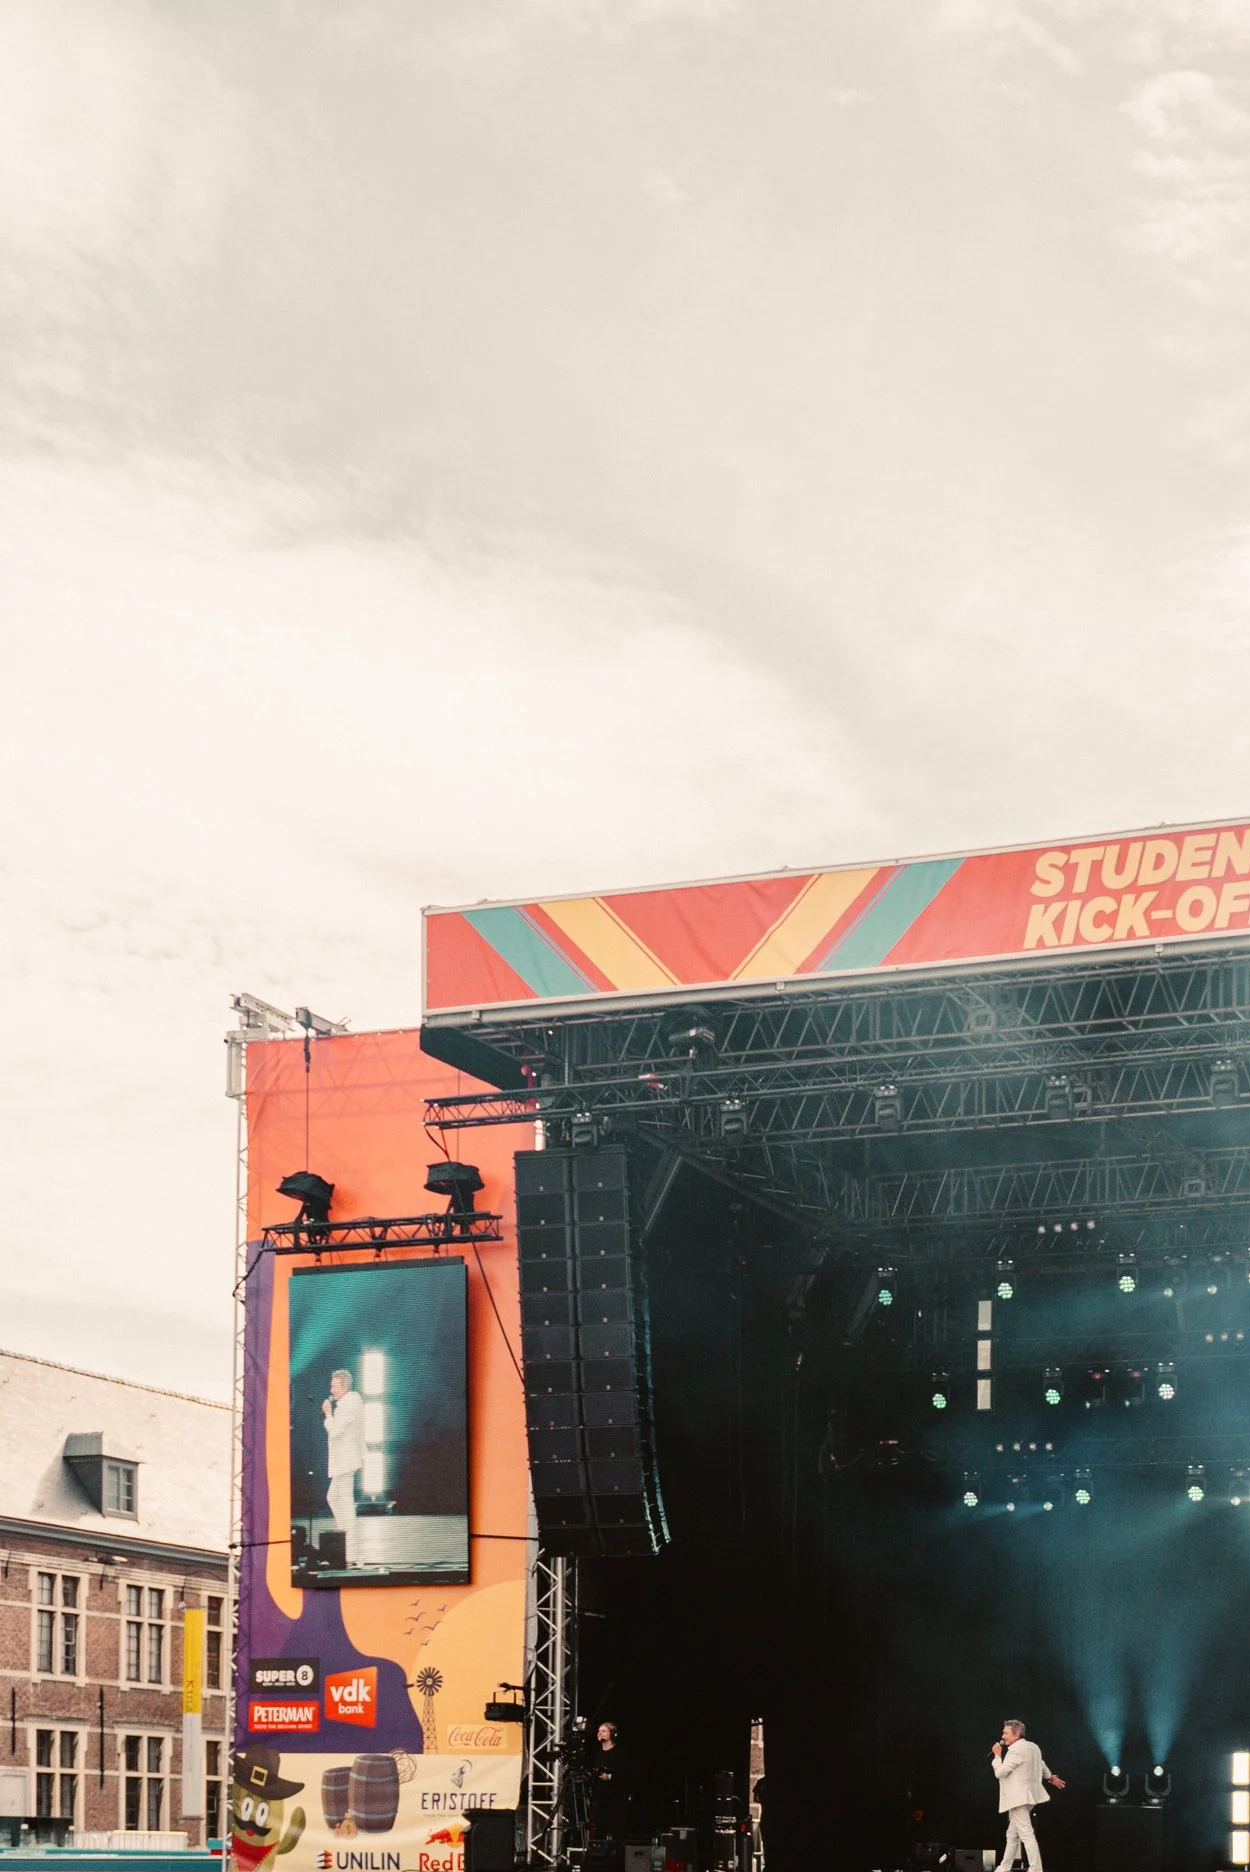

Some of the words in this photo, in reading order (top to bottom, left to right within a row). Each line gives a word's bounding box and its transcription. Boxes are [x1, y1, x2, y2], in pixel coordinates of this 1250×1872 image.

[255, 1669, 296, 1683] SUPER
[330, 1678, 371, 1702] vdk
[253, 1705, 314, 1723] PETERMAN
[338, 1703, 364, 1714] bank
[421, 1792, 497, 1810] ERISTOFF
[337, 1852, 400, 1870] UNILIN
[418, 1852, 453, 1872] Red
